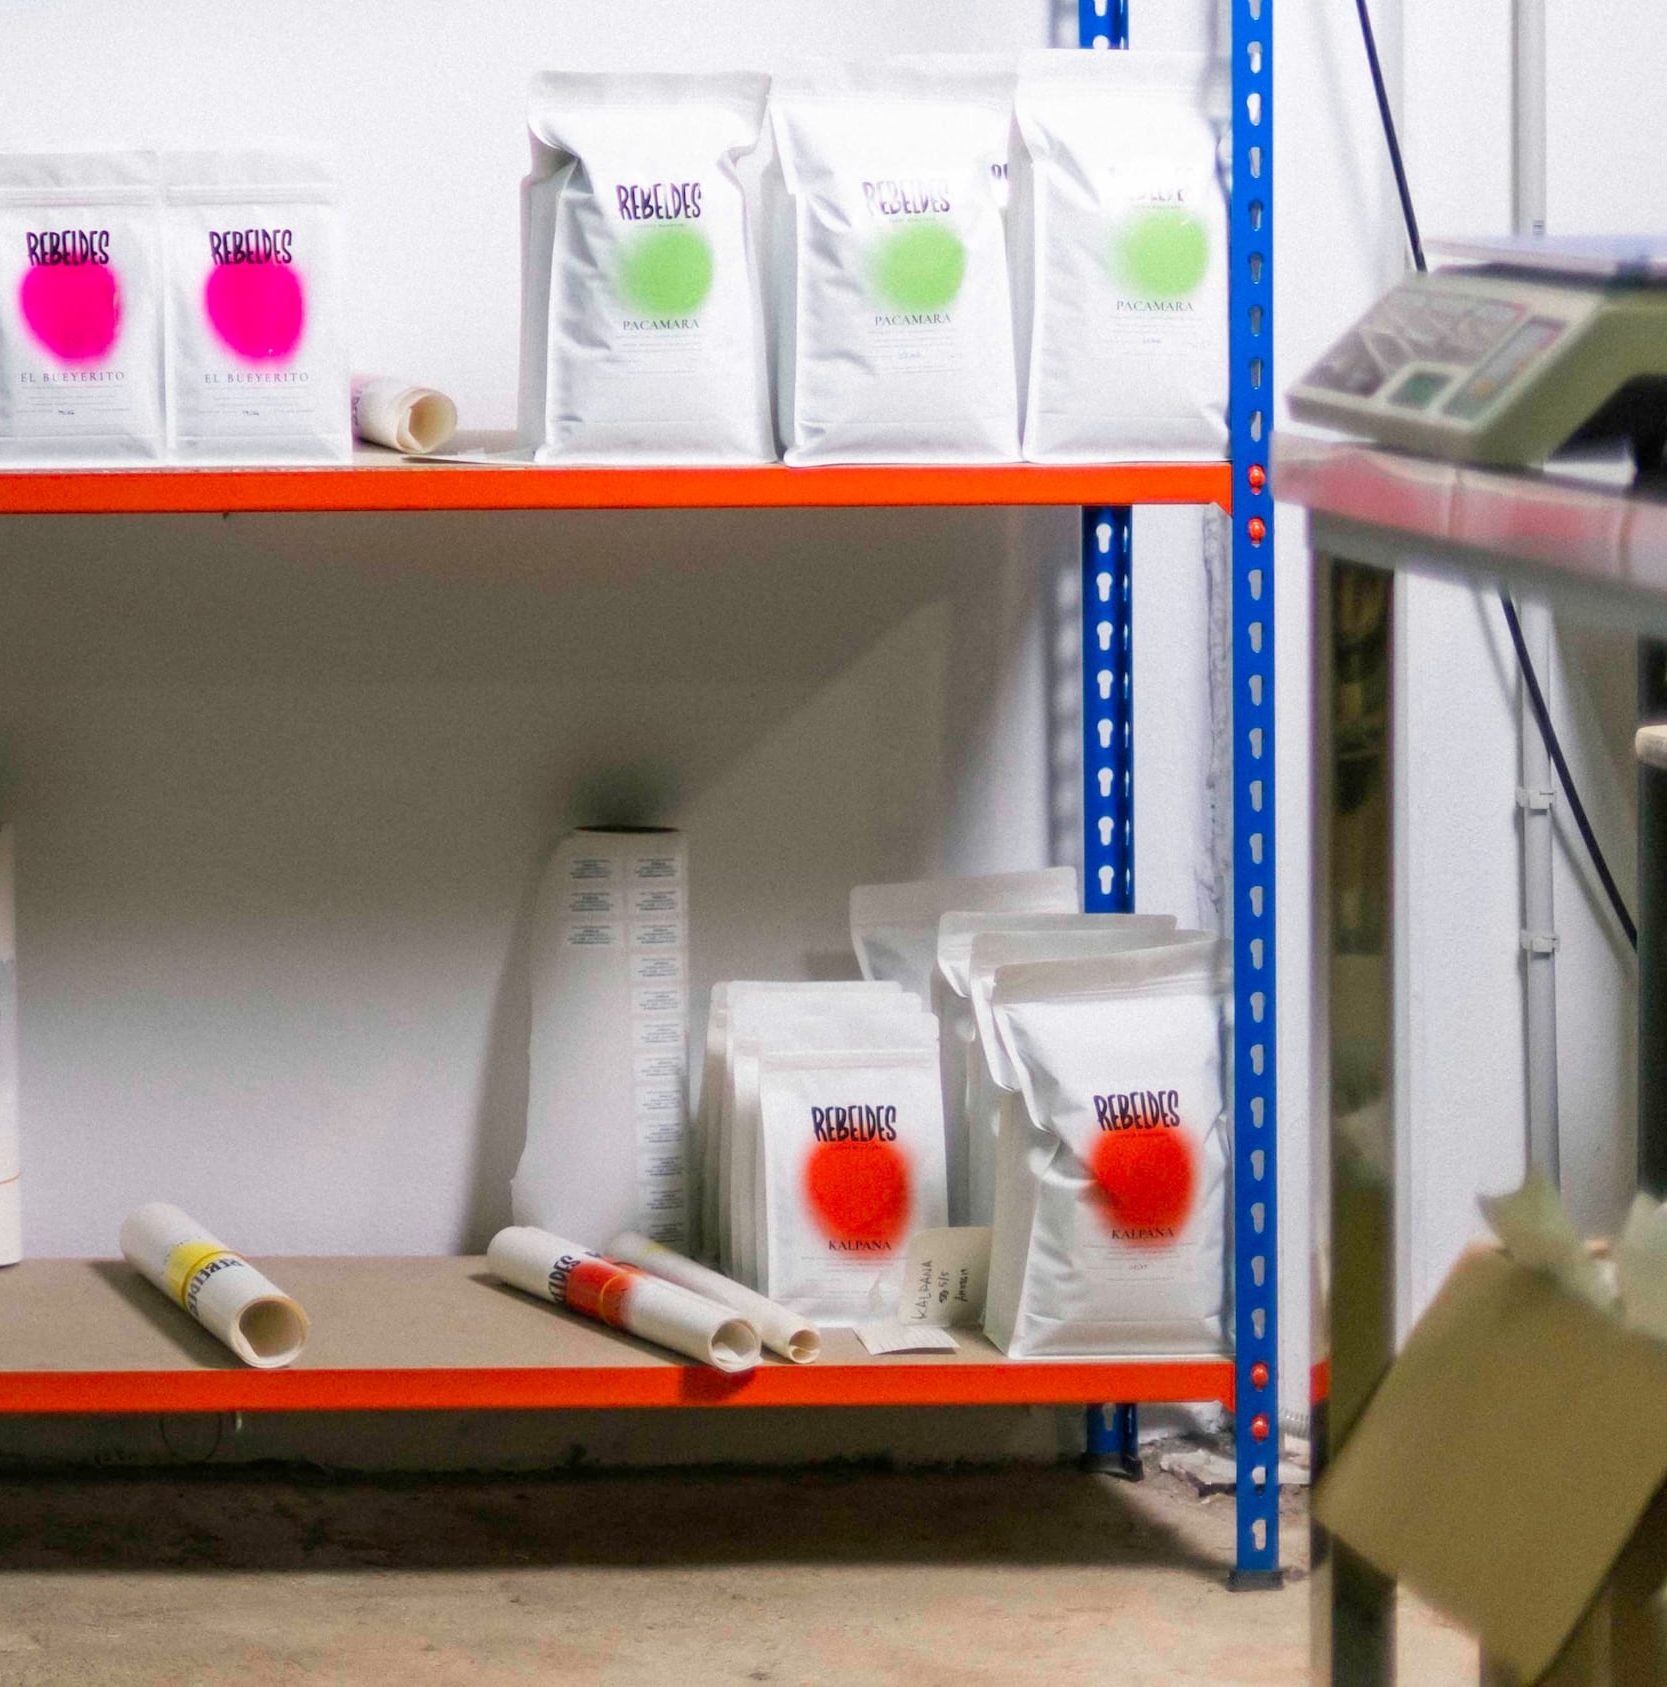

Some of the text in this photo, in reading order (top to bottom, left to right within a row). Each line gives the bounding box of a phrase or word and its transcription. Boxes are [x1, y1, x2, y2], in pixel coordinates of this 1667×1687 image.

[616, 183, 702, 220] REBELDES
[26, 230, 109, 265] REBELDES
[209, 229, 292, 265] REBELDES
[1116, 300, 1194, 312] PACAMARA
[623, 319, 700, 331] PACAMARA
[874, 314, 951, 327] PACAMARA
[21, 371, 125, 382] EL BUEYERITO
[204, 372, 309, 383] EL BUEYERITO
[1093, 1090, 1180, 1131] REBELDES
[811, 1105, 897, 1142] REBELDES
[1111, 1228, 1175, 1240] KALPANA
[828, 1240, 892, 1251] KALPANA
[911, 1260, 932, 1320] KALPANA
